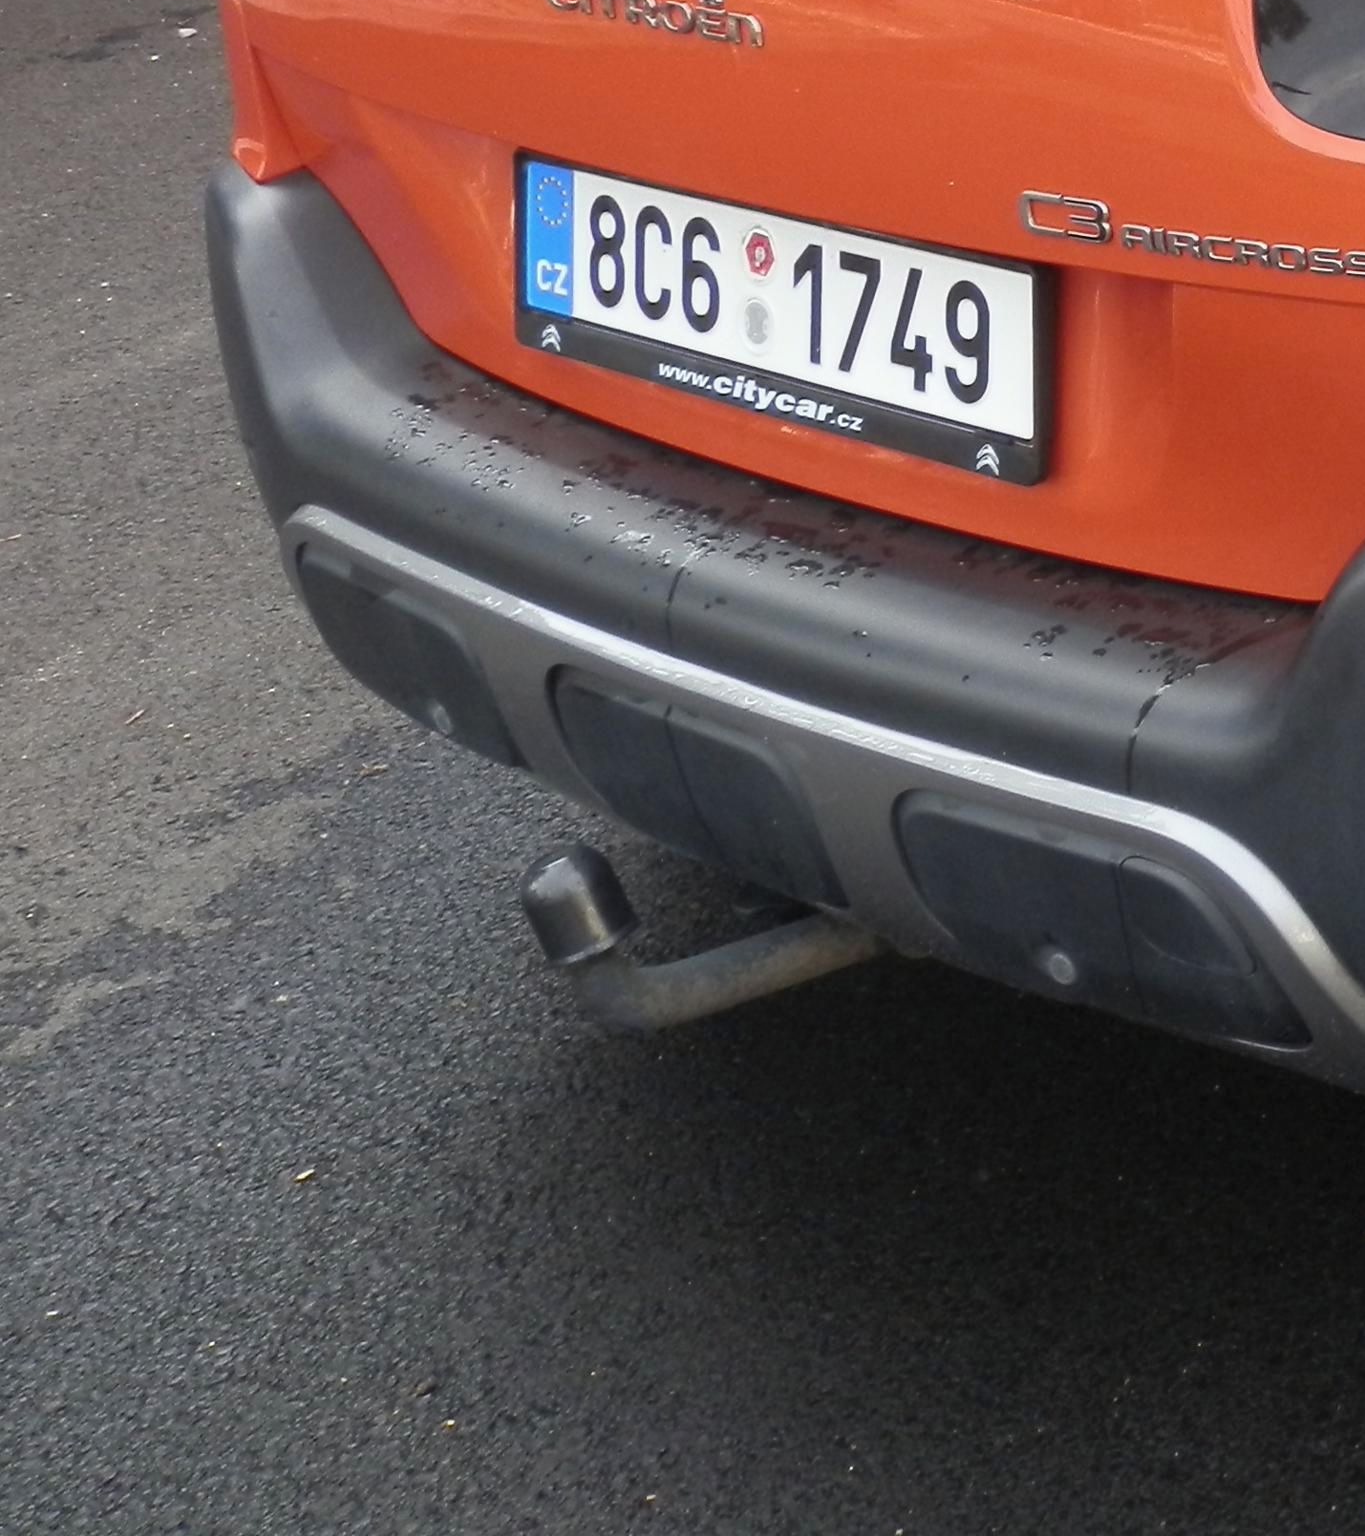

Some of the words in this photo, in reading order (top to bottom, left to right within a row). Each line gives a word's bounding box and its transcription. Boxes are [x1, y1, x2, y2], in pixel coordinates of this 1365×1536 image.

[1018, 189, 1113, 244] C3
[535, 257, 569, 297] CZ
[589, 194, 722, 334] 8C6
[792, 243, 991, 405] 1749
[658, 362, 864, 433] www.citycar.cz
